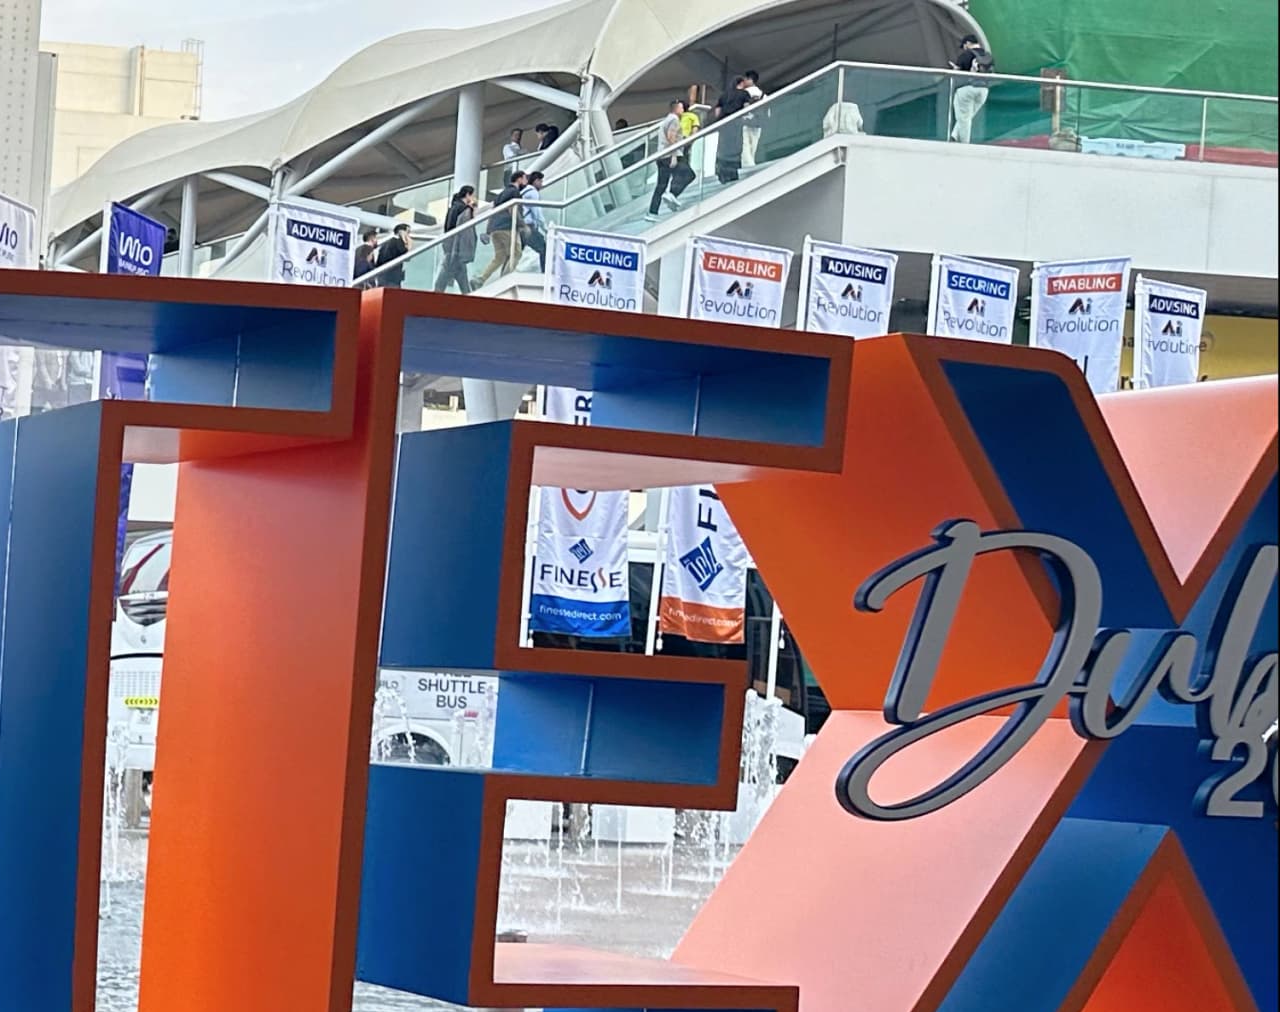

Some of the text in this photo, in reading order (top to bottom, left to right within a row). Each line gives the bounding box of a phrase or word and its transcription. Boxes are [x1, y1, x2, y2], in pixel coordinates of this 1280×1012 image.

[291, 223, 344, 247] ADVISING
[306, 247, 328, 267] Ai
[569, 245, 633, 268] SECURING
[707, 256, 777, 279] ENABLING
[828, 258, 884, 281] ADVISING
[588, 270, 613, 290] Ai
[726, 279, 754, 299] Ai
[950, 274, 1007, 297] SECURING
[1051, 275, 1117, 293] ENABLING
[558, 284, 637, 311] Revolution
[841, 282, 864, 301] Ai
[967, 297, 986, 316] Ai
[1068, 297, 1092, 316] Ai
[1045, 317, 1120, 336] Revolution
[1161, 319, 1183, 337] Ai
[539, 563, 623, 594] FINESSE
[417, 677, 487, 695] SHUTTLE
[436, 694, 468, 710] BUS
[1192, 733, 1278, 819] 2
